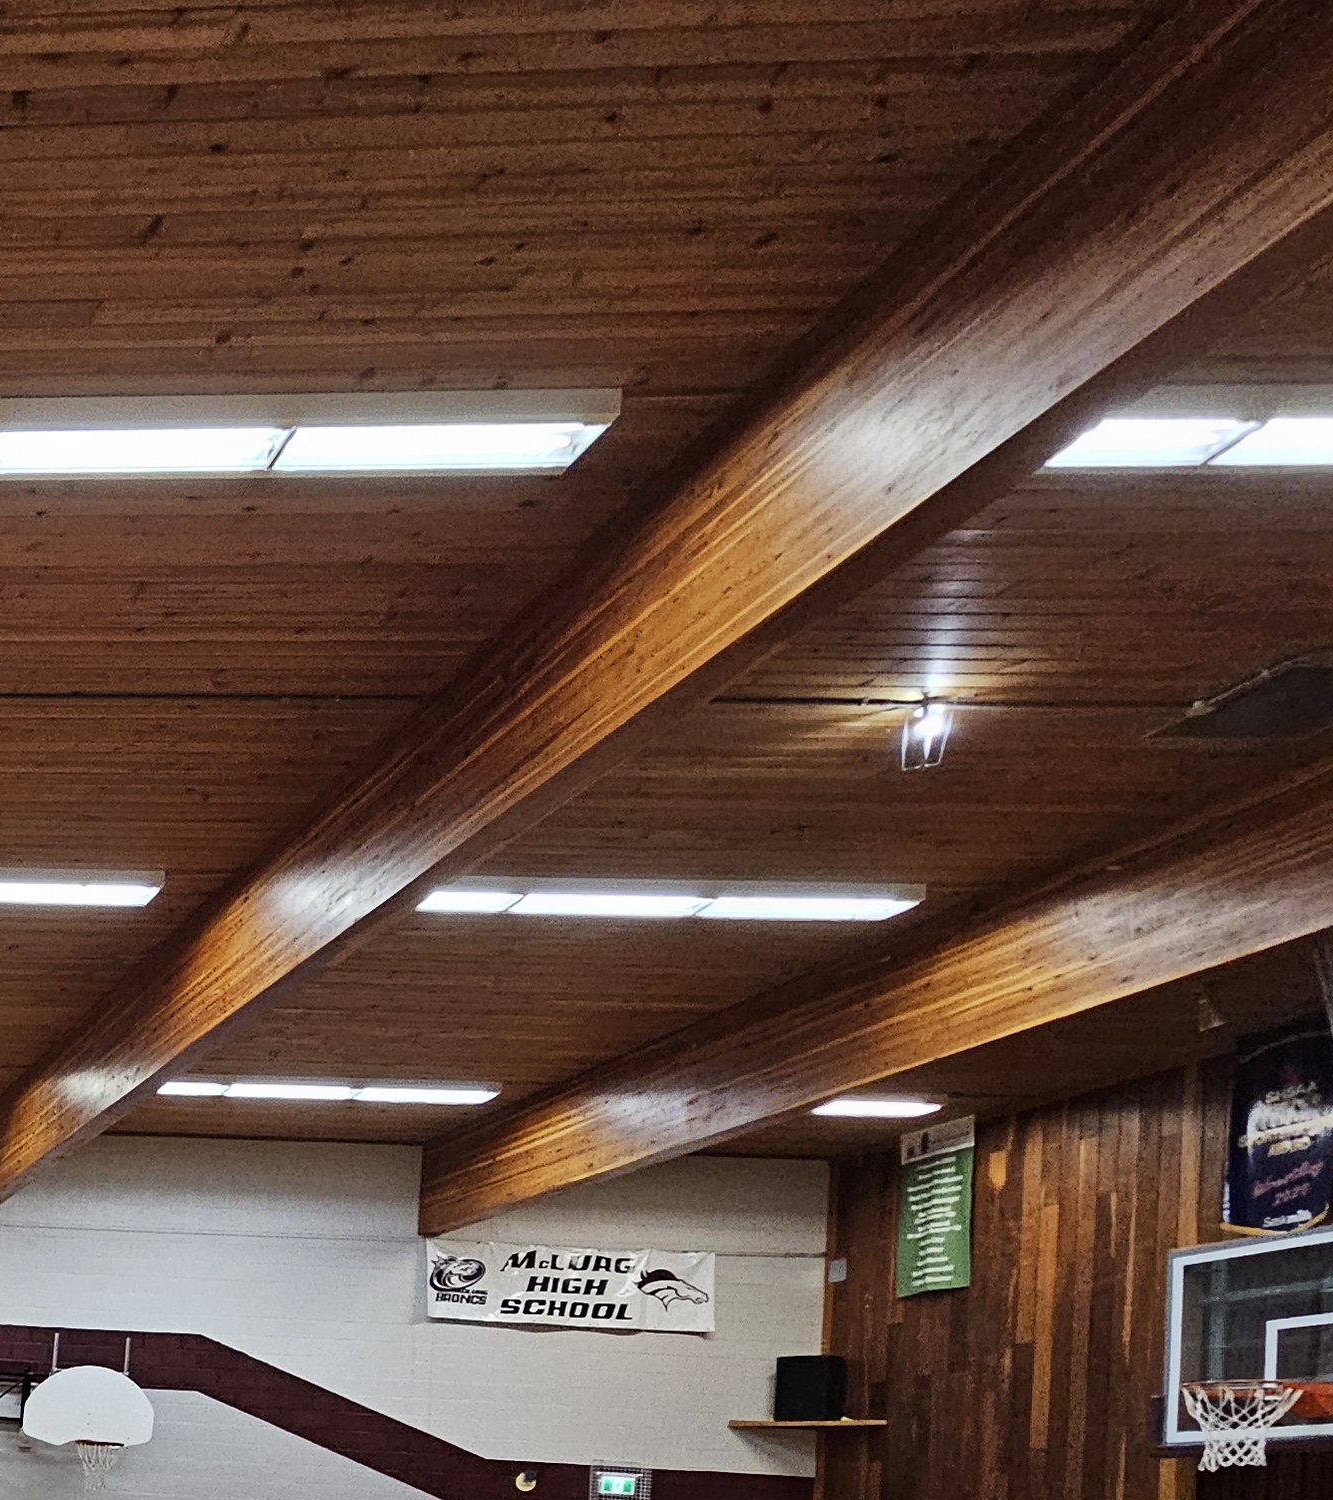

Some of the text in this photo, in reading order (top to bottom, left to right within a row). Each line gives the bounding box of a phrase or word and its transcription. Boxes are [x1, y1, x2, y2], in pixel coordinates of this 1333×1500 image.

[526, 1276, 608, 1295] HIGH
[435, 1292, 488, 1306] BRONCS
[500, 1299, 633, 1320] SCHOOL
